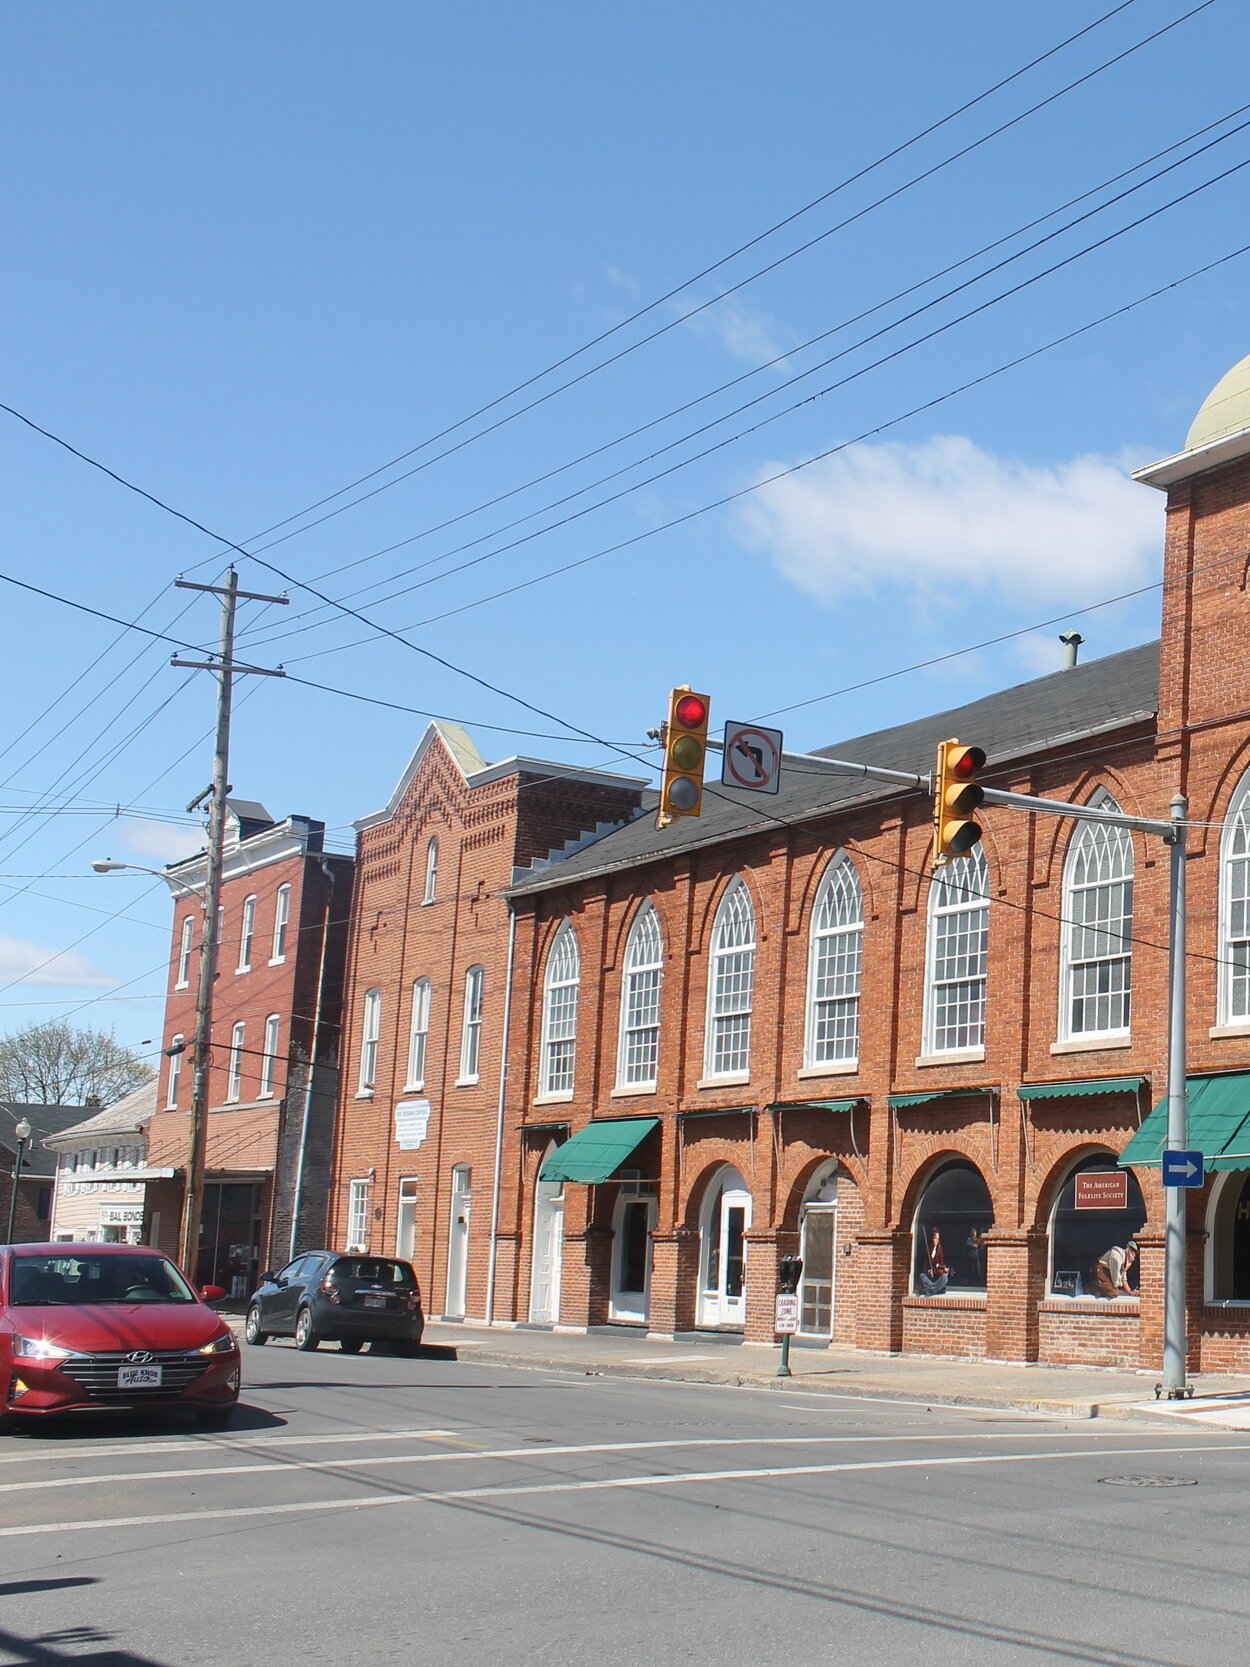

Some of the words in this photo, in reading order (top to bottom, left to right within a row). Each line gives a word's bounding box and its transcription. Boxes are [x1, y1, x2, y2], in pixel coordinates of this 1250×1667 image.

[1094, 1181, 1120, 1189] AMERICAN
[1078, 1192, 1101, 1200] FOLKLIFE
[1102, 1191, 1124, 1199] SOCIETY
[110, 1211, 121, 1221] BAIL
